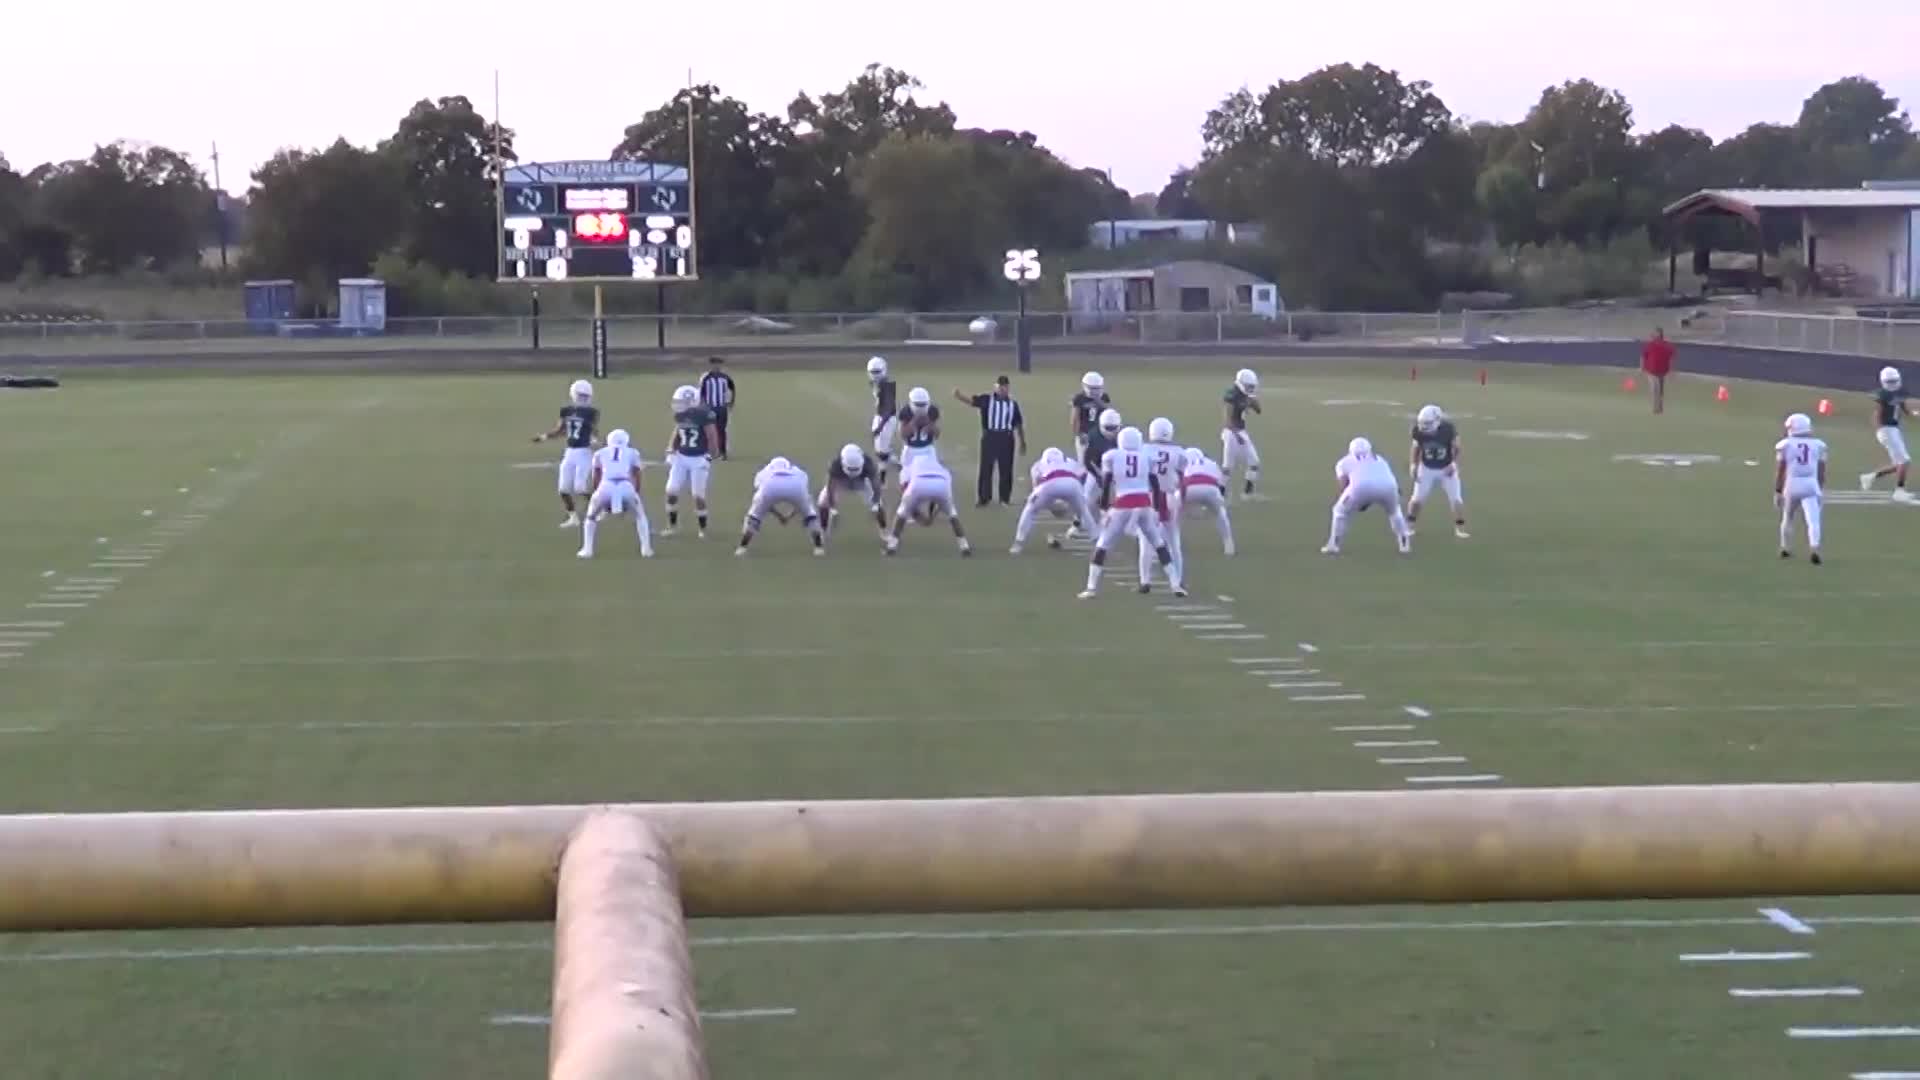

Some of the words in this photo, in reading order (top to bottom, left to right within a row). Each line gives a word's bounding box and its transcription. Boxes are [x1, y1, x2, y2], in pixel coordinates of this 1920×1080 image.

[1004, 248, 1041, 280] 25
[1126, 454, 1138, 478] 9
[1157, 451, 1169, 475] 2
[1797, 443, 1809, 466] 3
